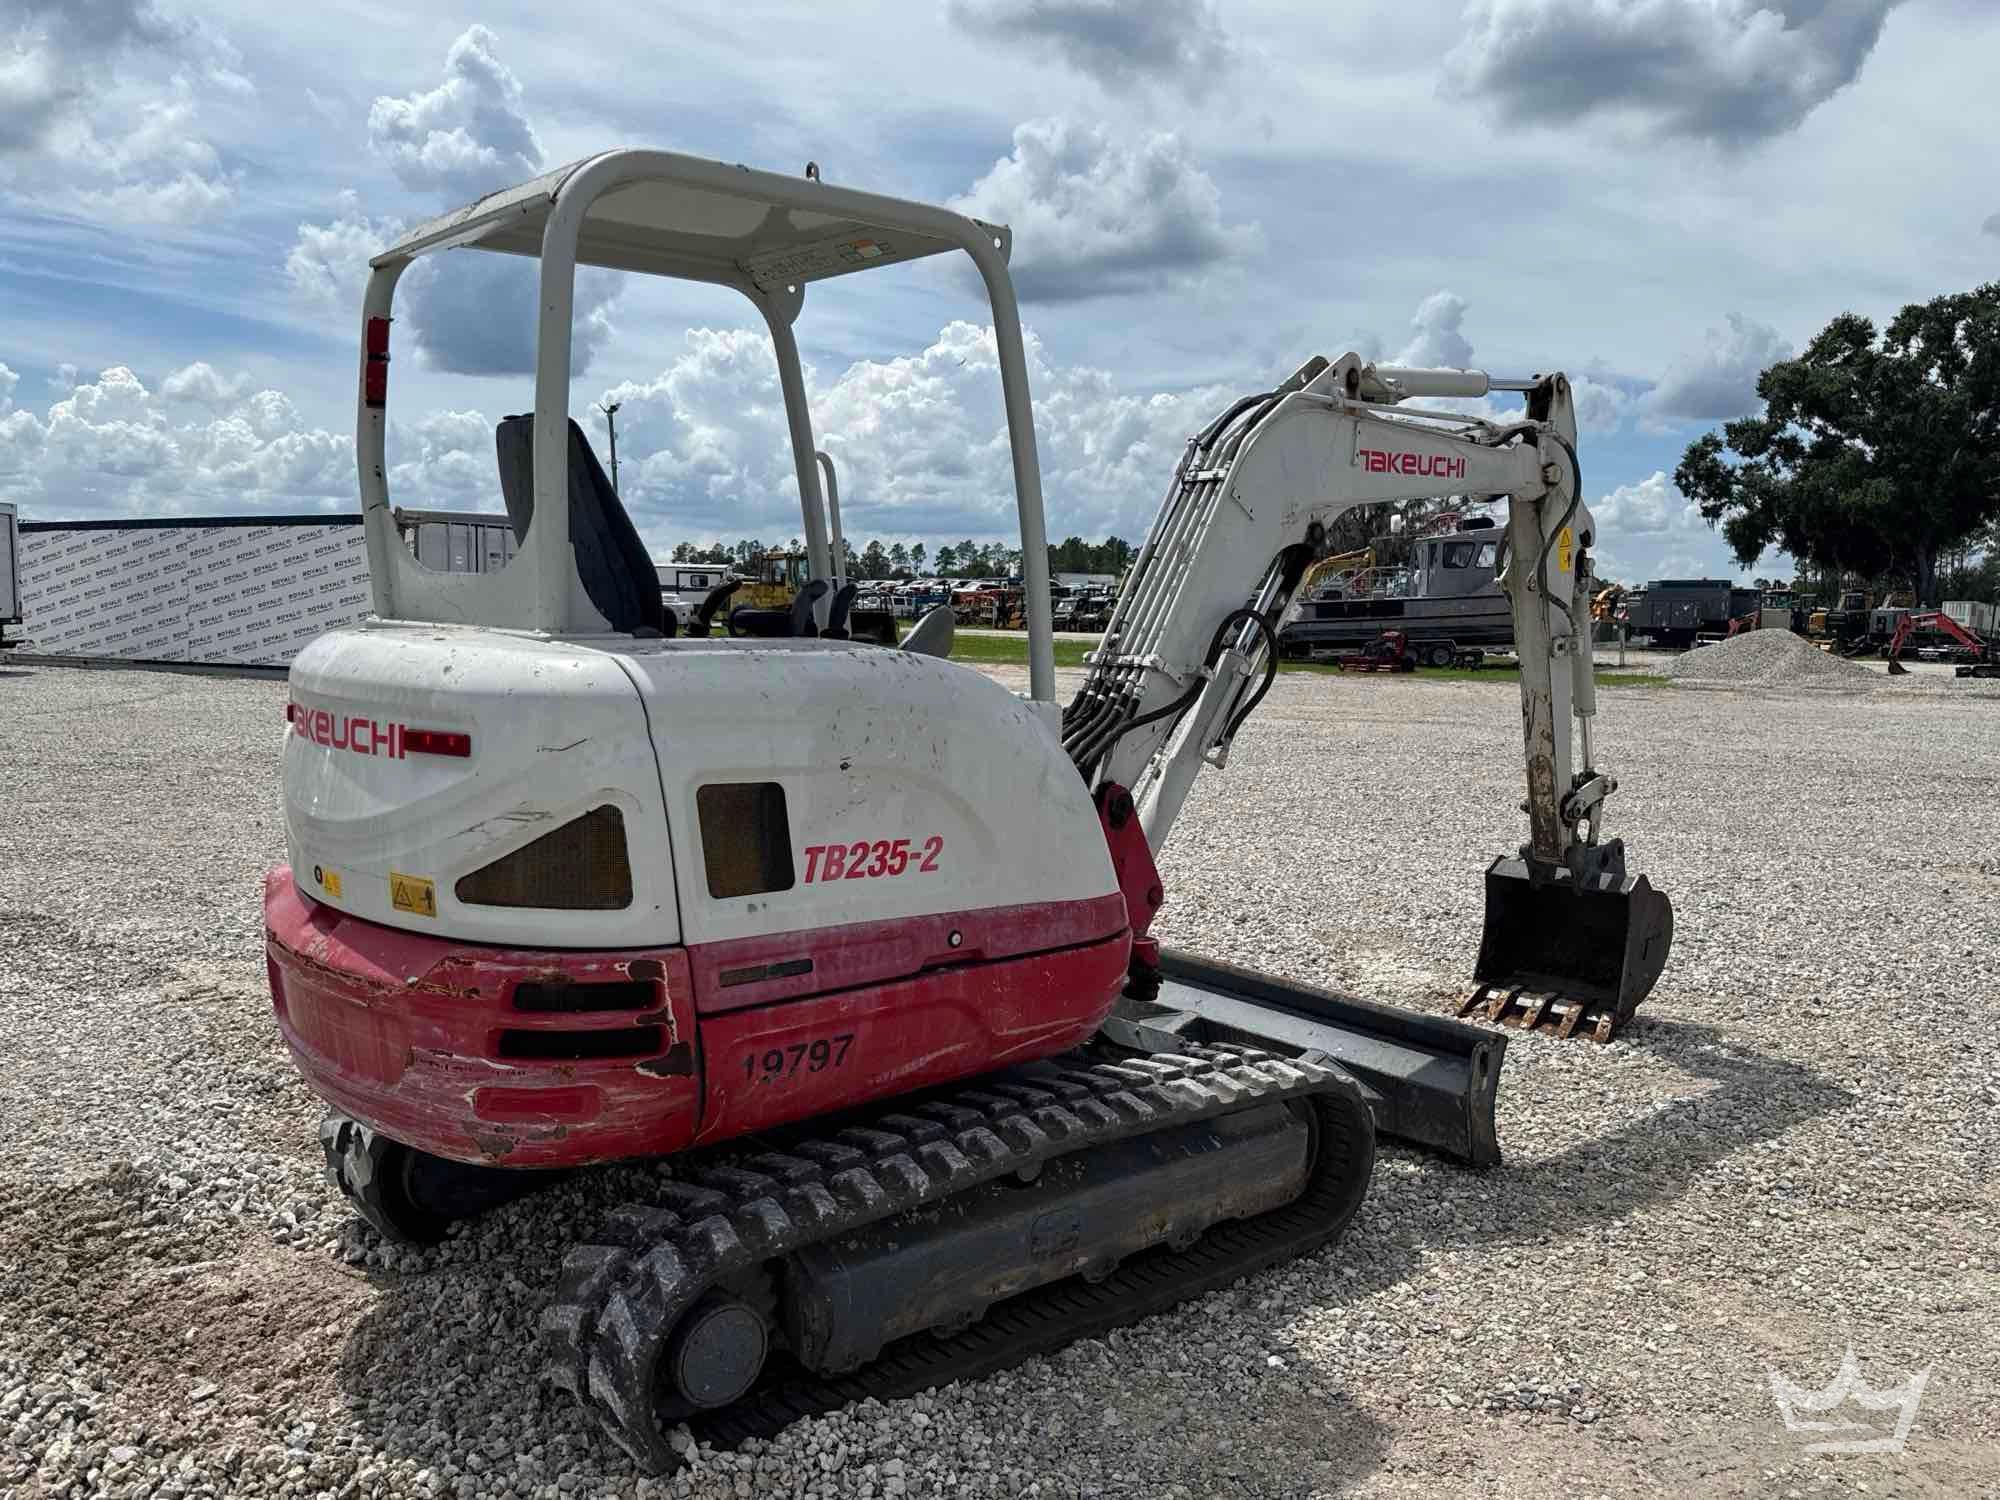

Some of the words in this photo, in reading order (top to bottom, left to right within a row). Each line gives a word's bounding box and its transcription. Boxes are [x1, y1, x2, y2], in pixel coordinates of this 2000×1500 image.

[1359, 448, 1465, 479] TAKEUCHI
[803, 835, 944, 884] TB235-2
[742, 1034, 855, 1083] 19797
